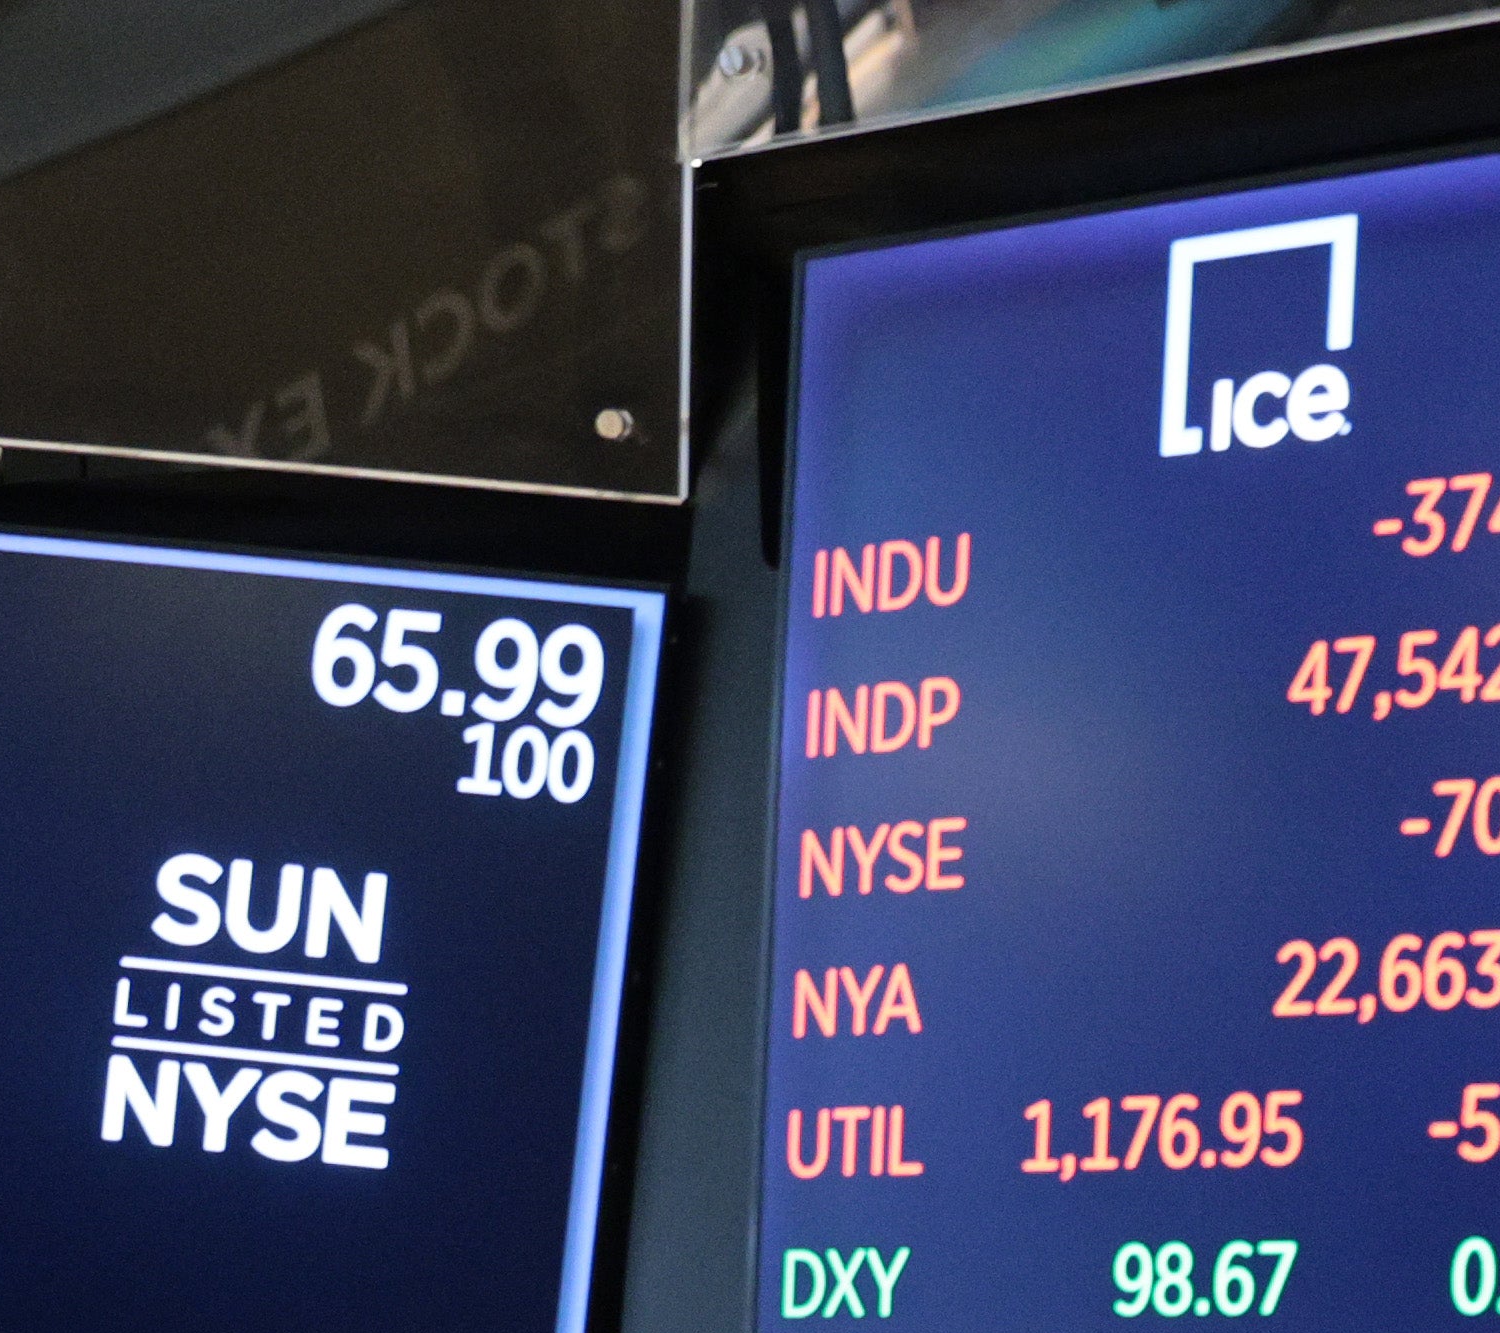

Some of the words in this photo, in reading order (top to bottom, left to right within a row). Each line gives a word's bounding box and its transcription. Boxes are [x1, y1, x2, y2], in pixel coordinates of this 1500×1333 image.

[812, 533, 972, 617] INDU
[310, 601, 600, 729] 65.99
[805, 677, 960, 757] INDP
[457, 724, 595, 804] 100
[798, 816, 966, 900] NYSE
[150, 851, 389, 963] SUN
[112, 976, 405, 1054] LISTED
[792, 964, 922, 1038] NYA
[101, 1056, 398, 1170] NYSE
[786, 1106, 923, 1179] UTIL
[1020, 1089, 1304, 1182] 1,176.95
[782, 1247, 910, 1321] DXY
[1113, 1240, 1298, 1317] 98.67
